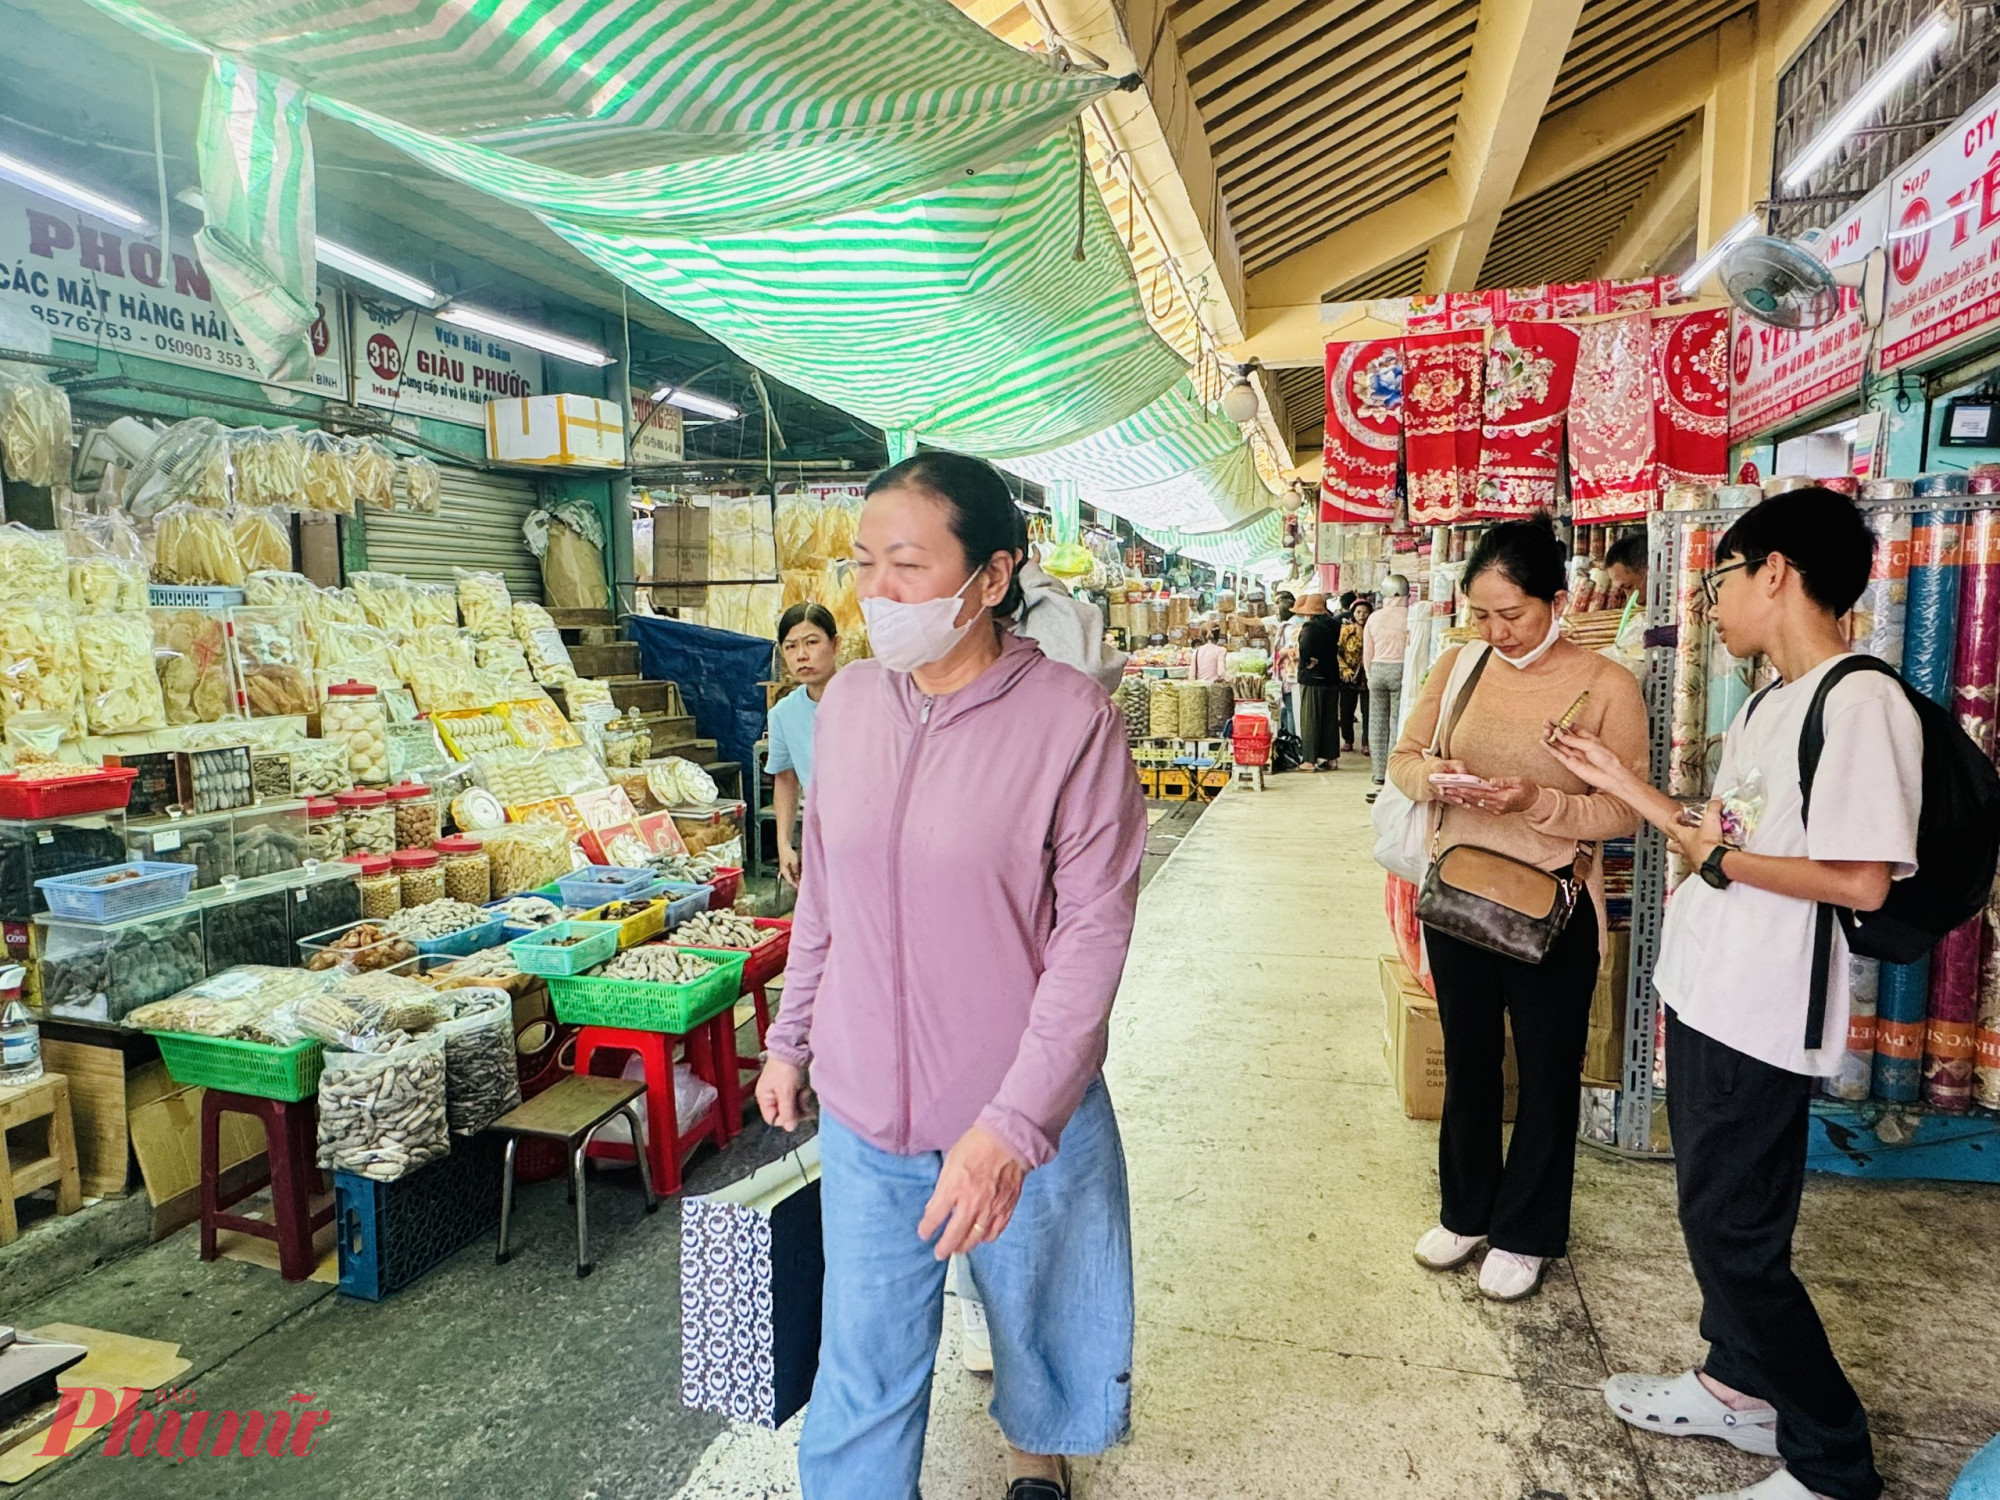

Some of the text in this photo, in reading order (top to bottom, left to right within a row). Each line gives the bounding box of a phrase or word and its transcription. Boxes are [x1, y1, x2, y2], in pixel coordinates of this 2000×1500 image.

[1964, 109, 1998, 158] CTY
[1847, 216, 1862, 247] DV
[120, 292, 185, 333] HÀNG
[191, 310, 227, 343] HẢI
[217, 348, 243, 370] 353
[369, 341, 399, 373] 313
[316, 374, 338, 389] BÌNH
[417, 349, 531, 398] GIÀU PHƯỚC
